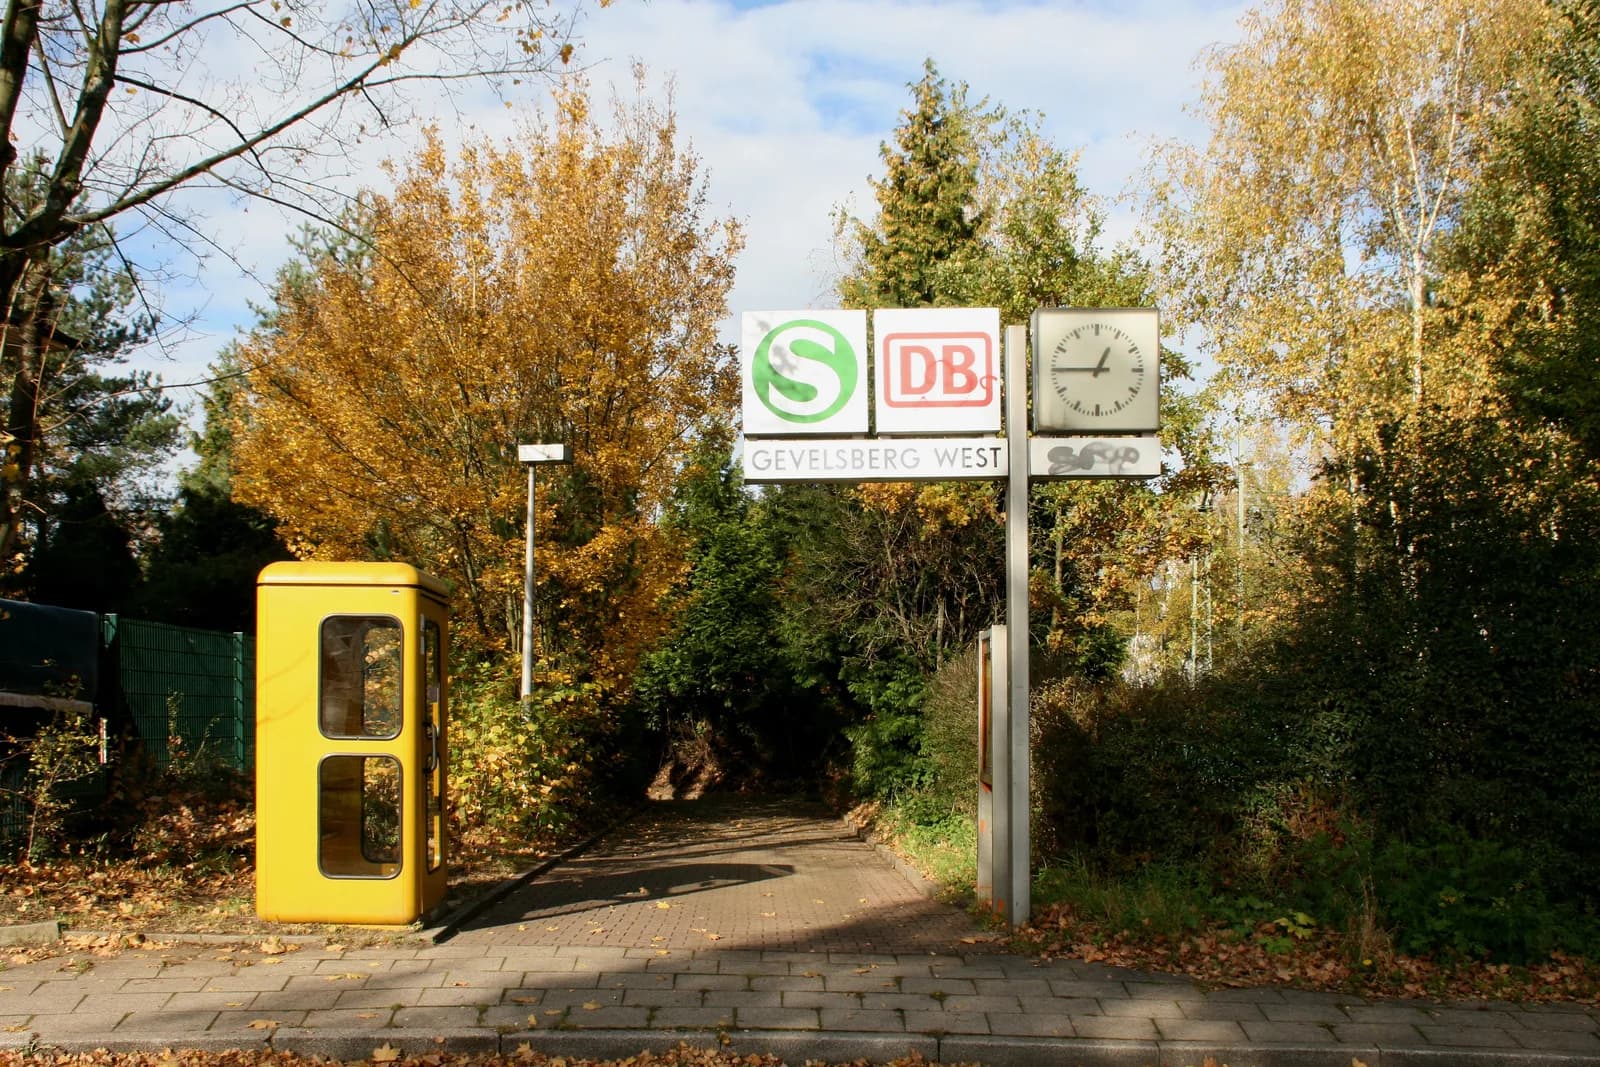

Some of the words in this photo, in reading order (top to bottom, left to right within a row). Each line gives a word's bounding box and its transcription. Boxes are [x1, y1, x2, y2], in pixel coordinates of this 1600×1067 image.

[768, 326, 840, 415] S
[900, 345, 977, 395] DB
[752, 449, 920, 471] GEVELSBERG
[936, 447, 1001, 468] WEST
